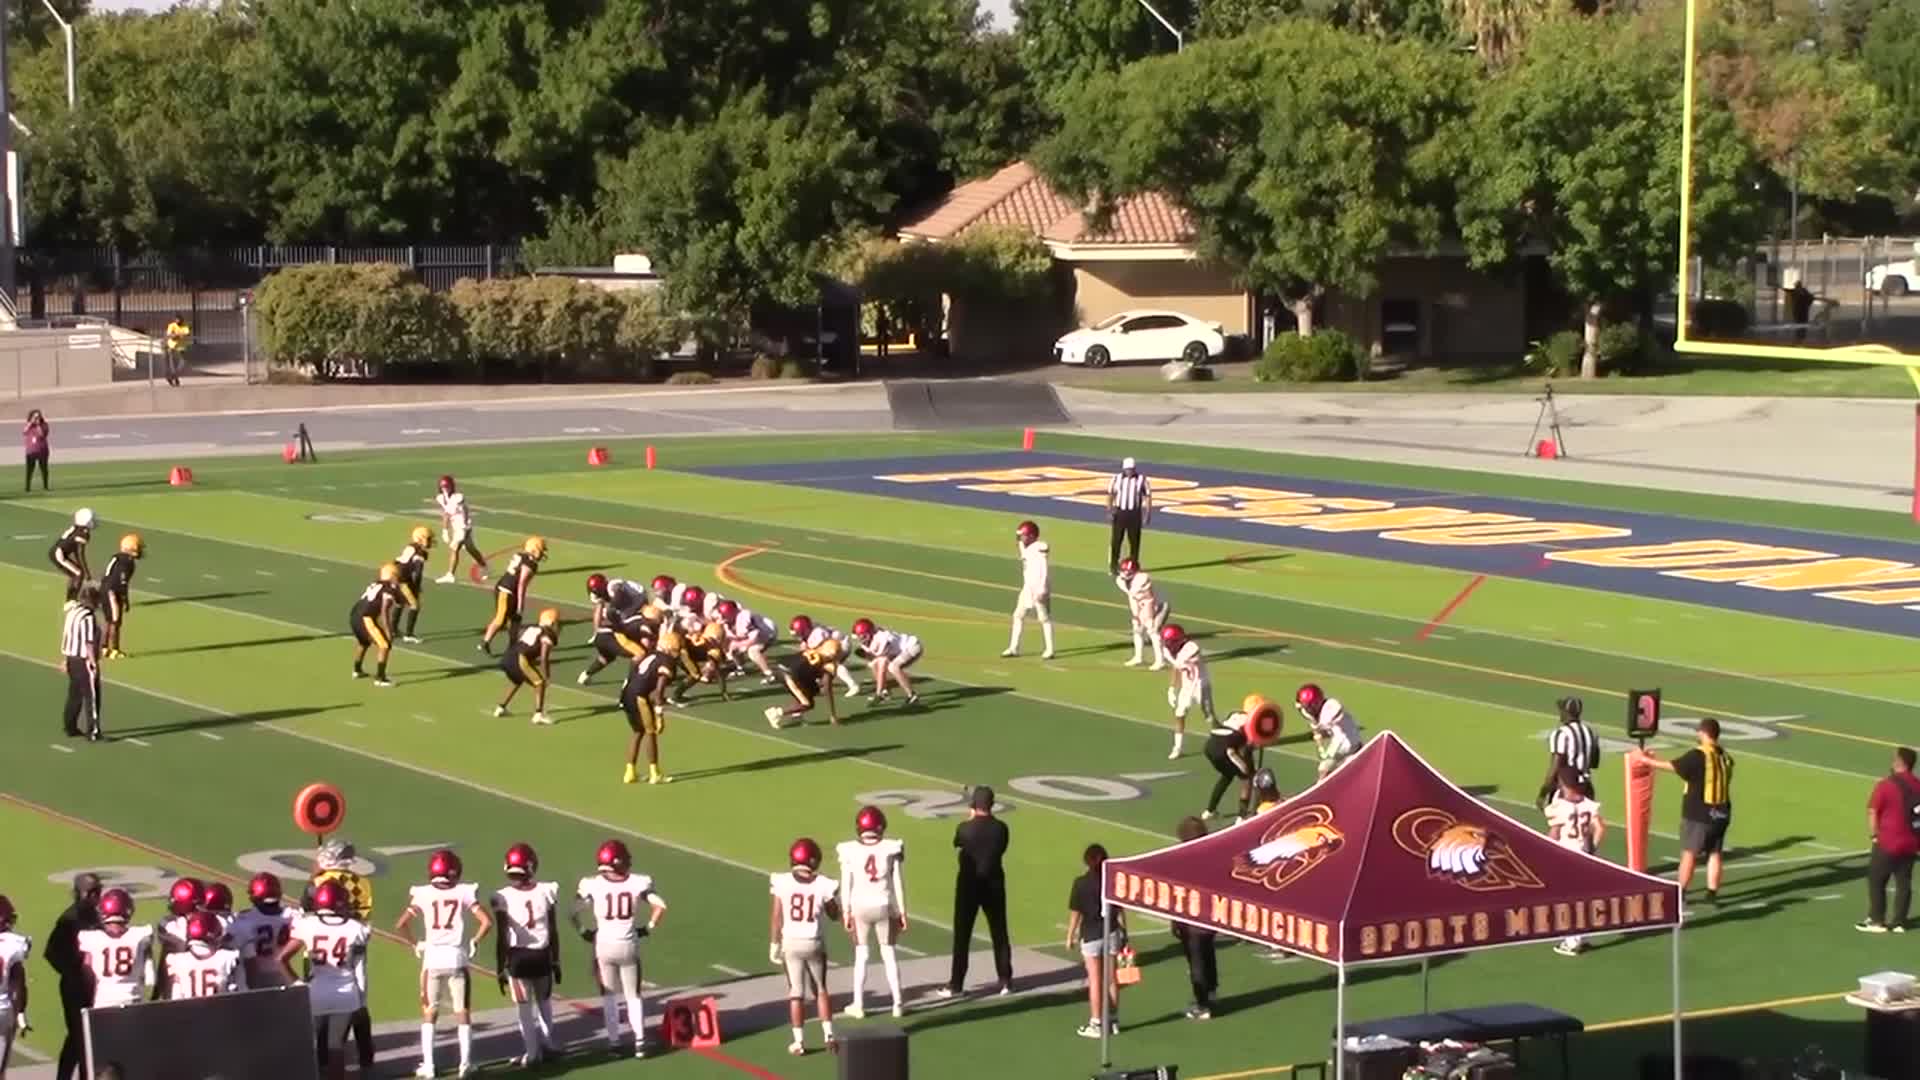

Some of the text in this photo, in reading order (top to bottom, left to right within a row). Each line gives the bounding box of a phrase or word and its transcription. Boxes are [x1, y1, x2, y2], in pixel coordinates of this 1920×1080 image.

[873, 466, 1632, 546] FRESNO
[864, 853, 879, 883] 4
[431, 899, 460, 931] 17
[524, 899, 537, 930] 1
[604, 892, 634, 921] 10
[790, 893, 817, 924] 81
[1114, 872, 1330, 954] SPORTS MEDICINE
[1360, 891, 1665, 955] SPORTS MEDICINE
[313, 924, 347, 967] 54
[101, 946, 134, 978] 18
[189, 968, 218, 999] 16
[672, 1003, 716, 1043] 30
